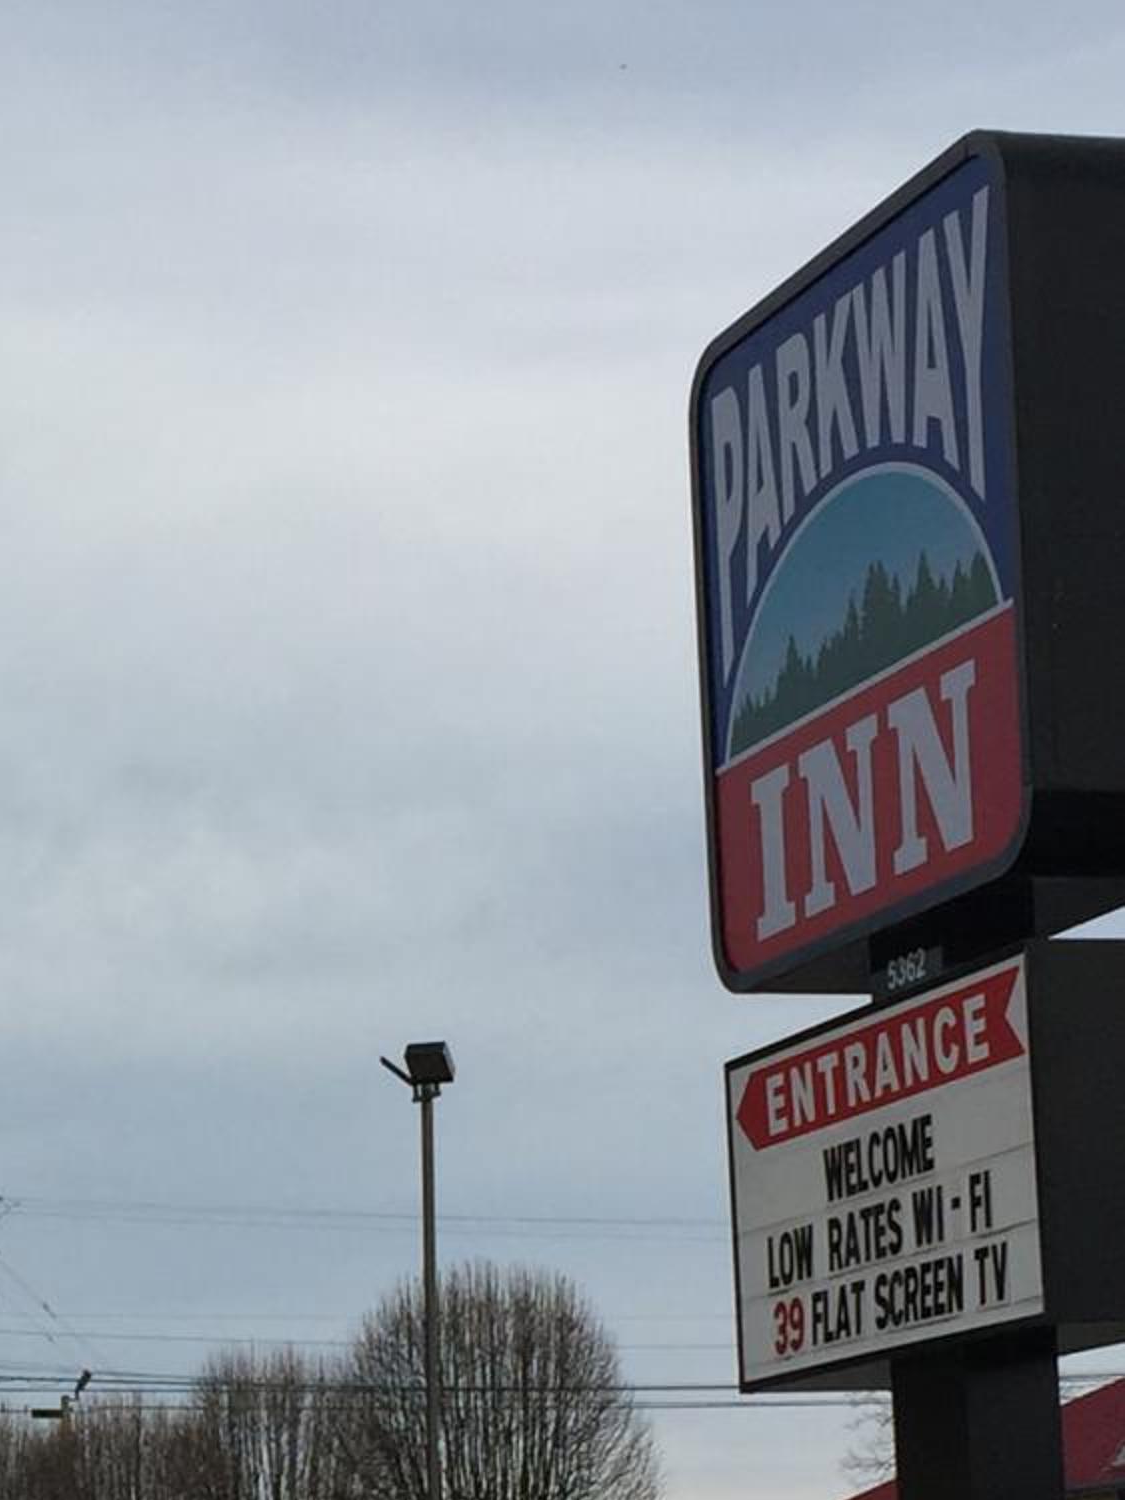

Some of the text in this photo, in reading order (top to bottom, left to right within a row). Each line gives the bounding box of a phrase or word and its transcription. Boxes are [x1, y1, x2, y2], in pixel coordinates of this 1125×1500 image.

[711, 185, 989, 690] PARKWAY
[751, 658, 976, 942] INN
[887, 948, 927, 990] 5362
[764, 993, 990, 1137] ENTRANCE
[822, 1113, 935, 1203] WELCOME
[767, 1224, 813, 1289] LOW
[828, 1198, 902, 1272] RATES
[774, 1241, 1008, 1355] 39 FLAT SCREEN TV
